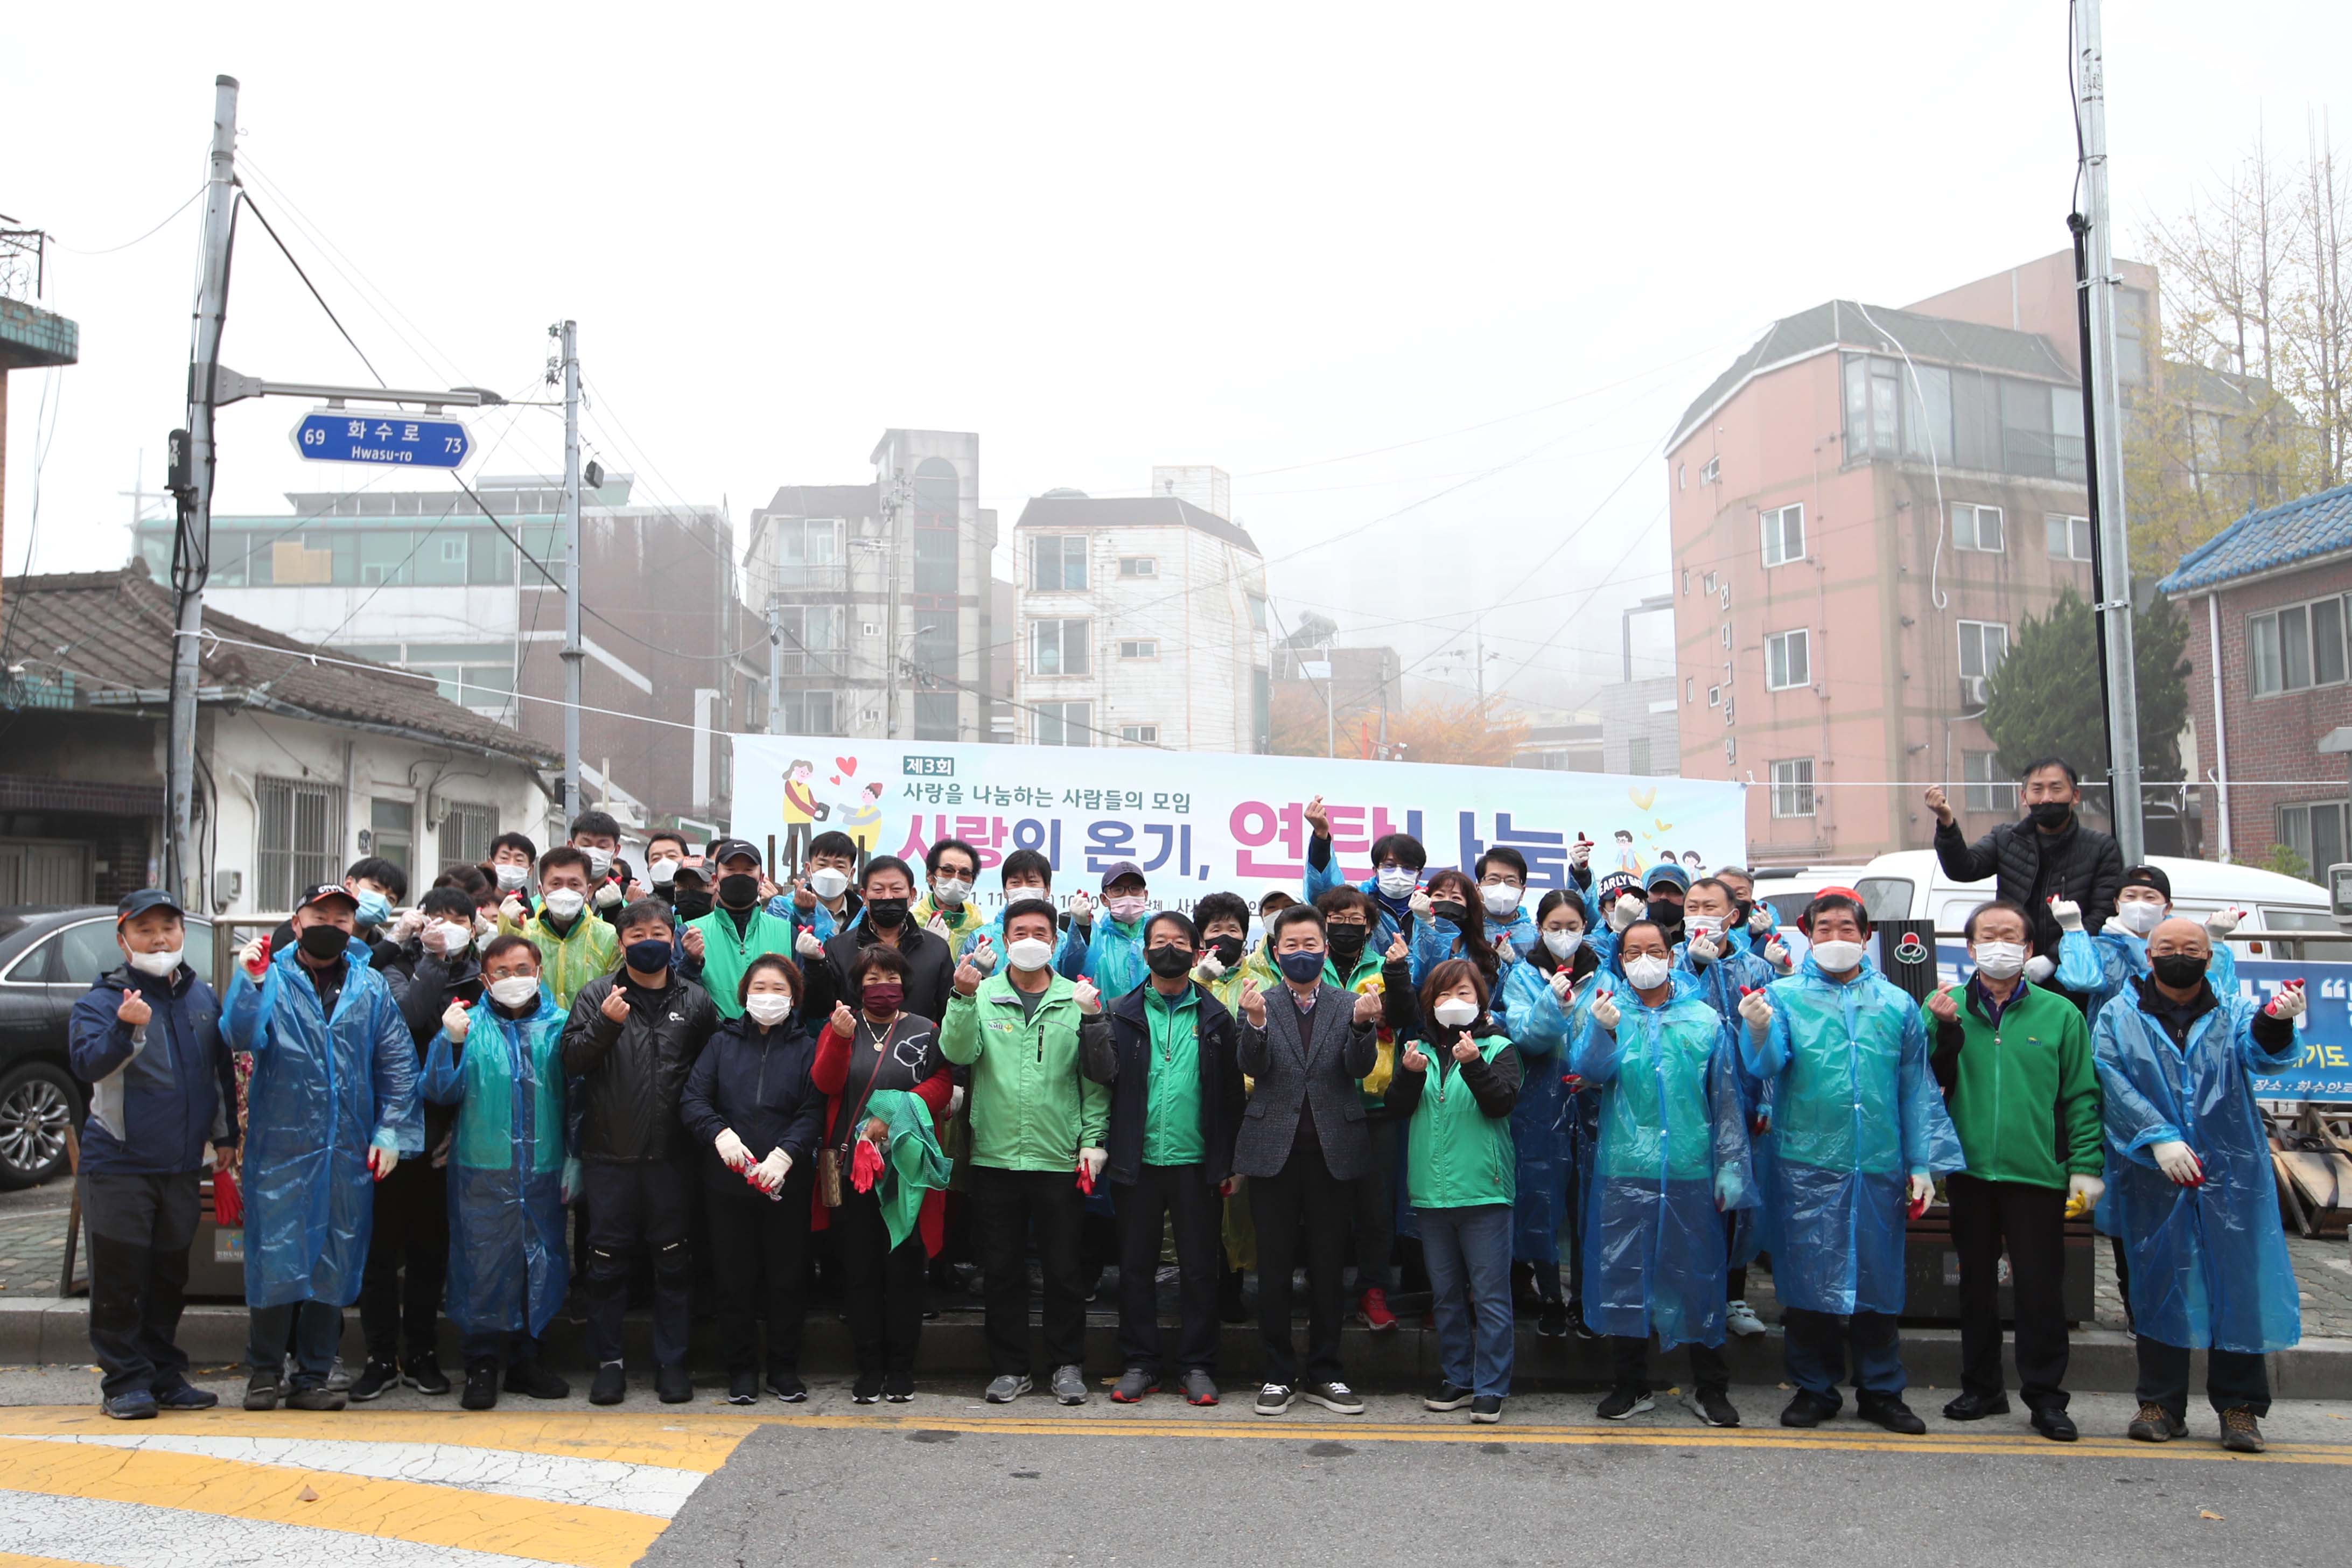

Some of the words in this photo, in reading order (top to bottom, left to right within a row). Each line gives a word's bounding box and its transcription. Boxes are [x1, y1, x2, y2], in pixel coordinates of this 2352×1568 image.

[304, 429, 325, 445] 69
[347, 419, 421, 442] 화수로
[444, 437, 461, 453] 73
[352, 446, 412, 463] Hwasu-ro
[1720, 582, 1737, 783] 현대그린맨
[906, 758, 952, 775] 제3회
[903, 782, 964, 804] 사랑을
[973, 785, 1053, 808] 나눔하는
[1062, 789, 1143, 810] 사람들의
[1151, 793, 1190, 814] 모임
[1084, 820, 1210, 881] 온기,
[2293, 1045, 2349, 1069] 기도
[2253, 1079, 2282, 1092] 장소
